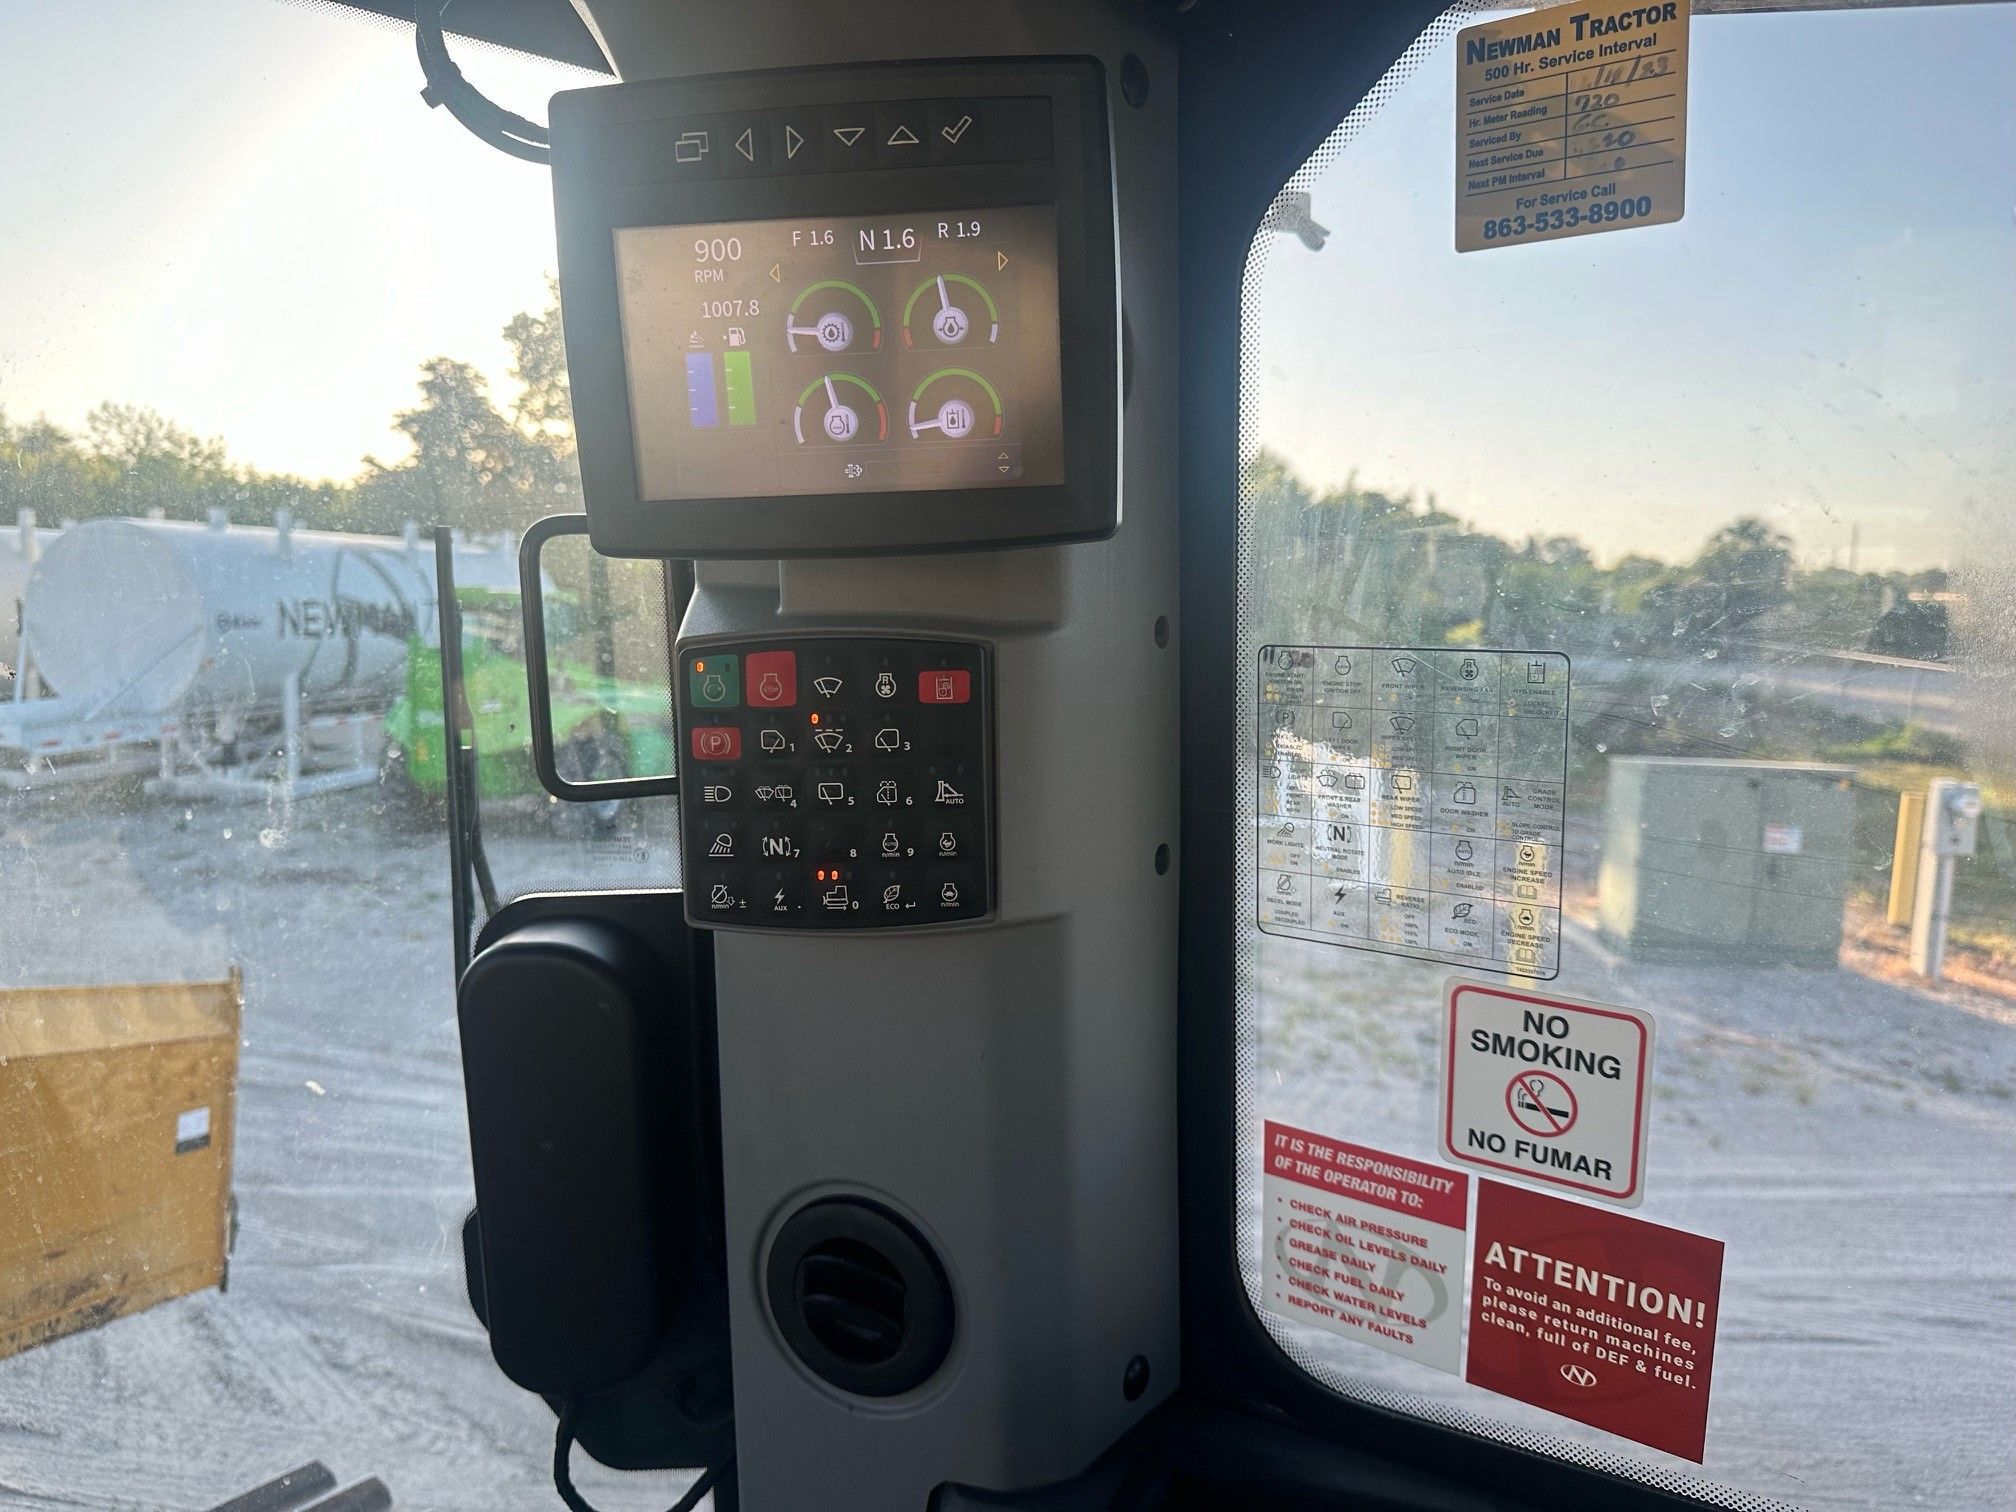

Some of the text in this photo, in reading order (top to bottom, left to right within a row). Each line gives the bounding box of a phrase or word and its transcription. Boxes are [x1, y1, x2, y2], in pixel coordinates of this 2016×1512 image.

[1466, 2, 1677, 65] NEWMAN TRACTOR
[1485, 34, 1657, 82] 500 Hr. Service Interval
[1470, 89, 1524, 108] Service Date
[1469, 106, 1547, 128] Hr. Meter Reading
[1469, 132, 1521, 149] Serviced By
[1469, 149, 1543, 169] Next Service Due
[1468, 170, 1545, 191] Next PM Interval
[1516, 183, 1616, 210] For Service Call
[1483, 196, 1652, 240] 863-533-8900
[792, 231, 834, 246] F 1.6
[859, 228, 916, 251] N 1.6
[937, 222, 981, 238] R 1.9
[694, 237, 742, 263] 900
[694, 269, 724, 283] RPM
[702, 300, 760, 319] 1007.8
[1283, 713, 1289, 722] P
[710, 737, 721, 749] P
[846, 744, 852, 753] 2
[904, 742, 910, 751] 3
[790, 799, 797, 808] 4
[848, 797, 854, 805] 5
[906, 797, 912, 805] 6
[1333, 826, 1345, 841] N
[769, 839, 783, 855] N
[794, 849, 800, 857] 7
[850, 849, 856, 857] 8
[907, 848, 914, 856] 9
[1503, 867, 1552, 877] ENGINE SPEED
[1510, 875, 1545, 884] INCREASE
[852, 901, 859, 910] 0
[1396, 895, 1424, 903] REVERSE
[1501, 931, 1550, 943] ENGINE SPEED
[1507, 939, 1543, 949] DECREASE
[1522, 1010, 1570, 1040] NO
[1470, 1028, 1622, 1081] SMOKING
[1275, 1134, 1454, 1194] IT IS THE RESPONSIBILITY
[1467, 1128, 1613, 1181] NO FUMAR
[1275, 1155, 1423, 1208] OF THE OPERATOR TO:
[1290, 1199, 1428, 1248] CHECK AIR PRESSURE
[1289, 1219, 1448, 1274] CHECK OIL LEVELS DAILY
[1289, 1238, 1376, 1272] GREASE DAILY
[1289, 1257, 1405, 1302] CHECK FUEL DAILY
[1484, 1241, 1706, 1328] ATTENTION!
[1289, 1276, 1426, 1329] CHECK WATER LEVELS
[1288, 1295, 1413, 1344] REPORT ANY FAULTS
[1484, 1276, 1696, 1355] To avoid an additional fee,
[1482, 1294, 1695, 1370] please return machines
[1481, 1310, 1696, 1389] clean, full of DEF & fuel.
